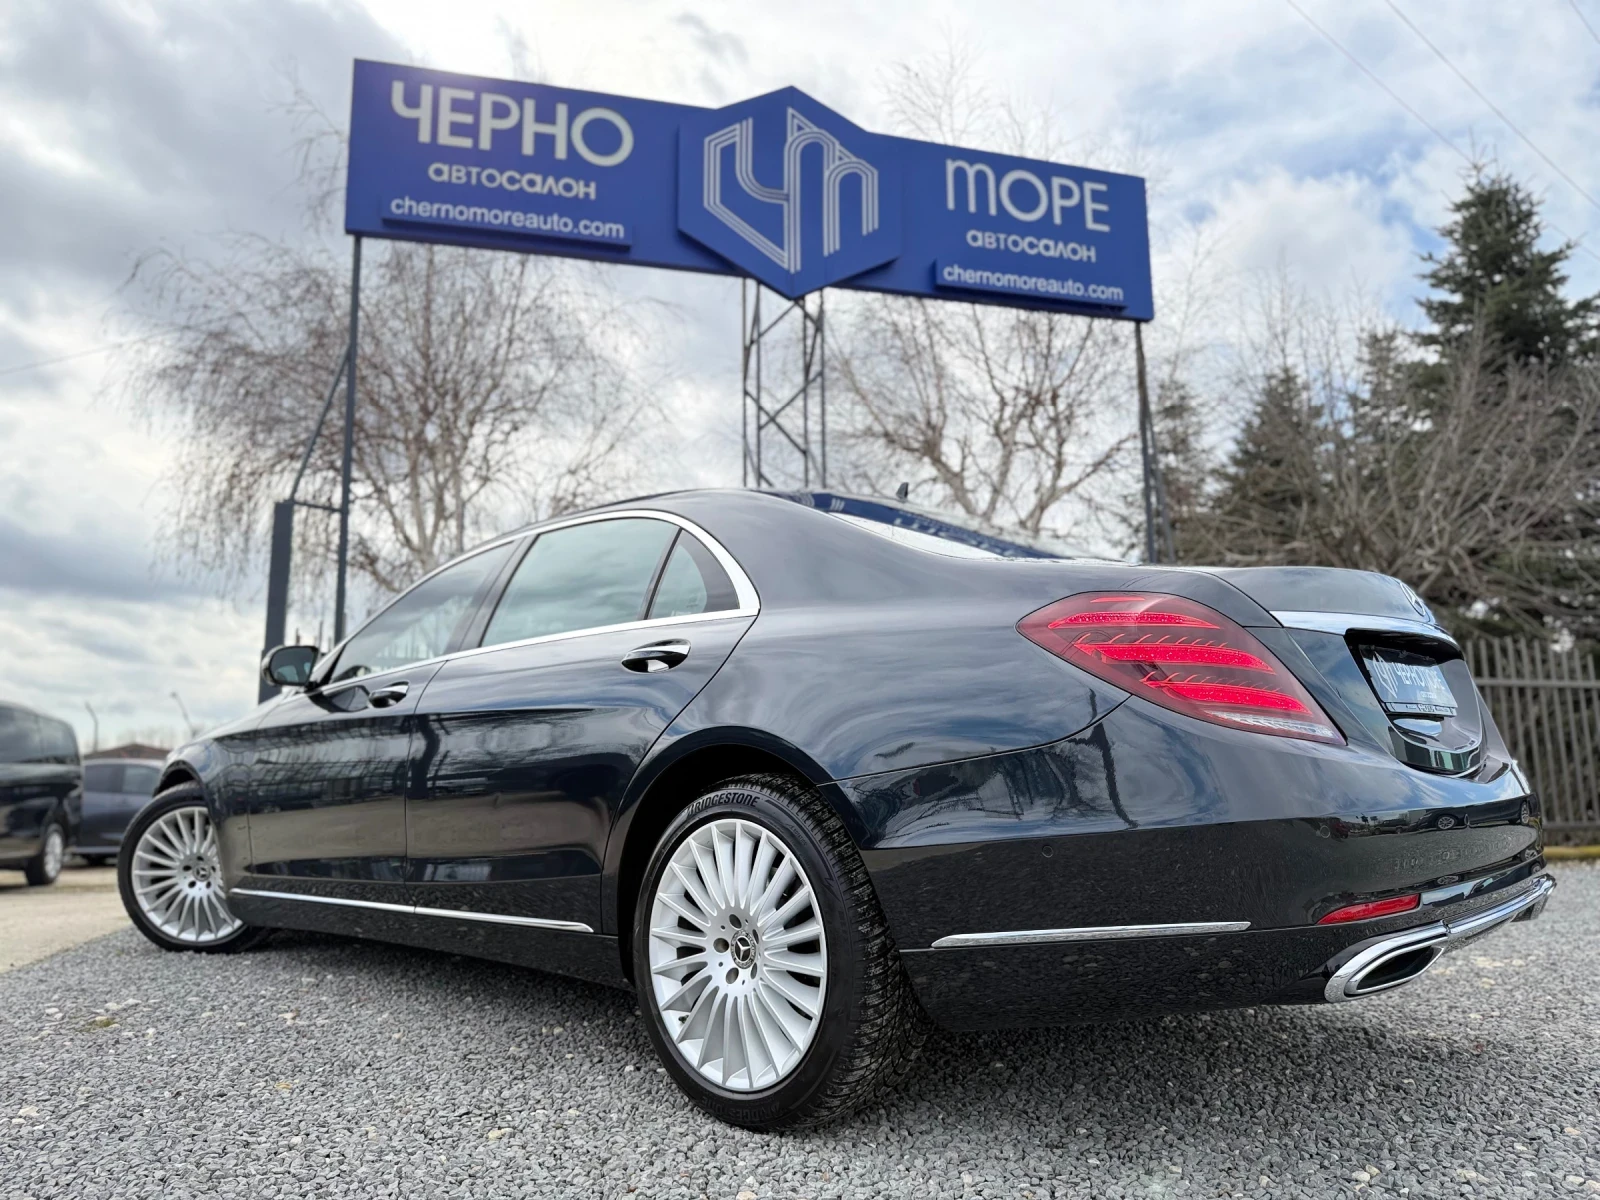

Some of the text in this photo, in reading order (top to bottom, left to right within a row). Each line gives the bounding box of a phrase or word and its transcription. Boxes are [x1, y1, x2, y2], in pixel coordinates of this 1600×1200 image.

[391, 80, 634, 167] ЧЕРНО
[946, 158, 1111, 233] МОРЕ
[391, 196, 625, 239] chernomoreauto.com
[943, 264, 1124, 301] chernomoreauto.com
[686, 792, 760, 817] BRIDGESTONE
